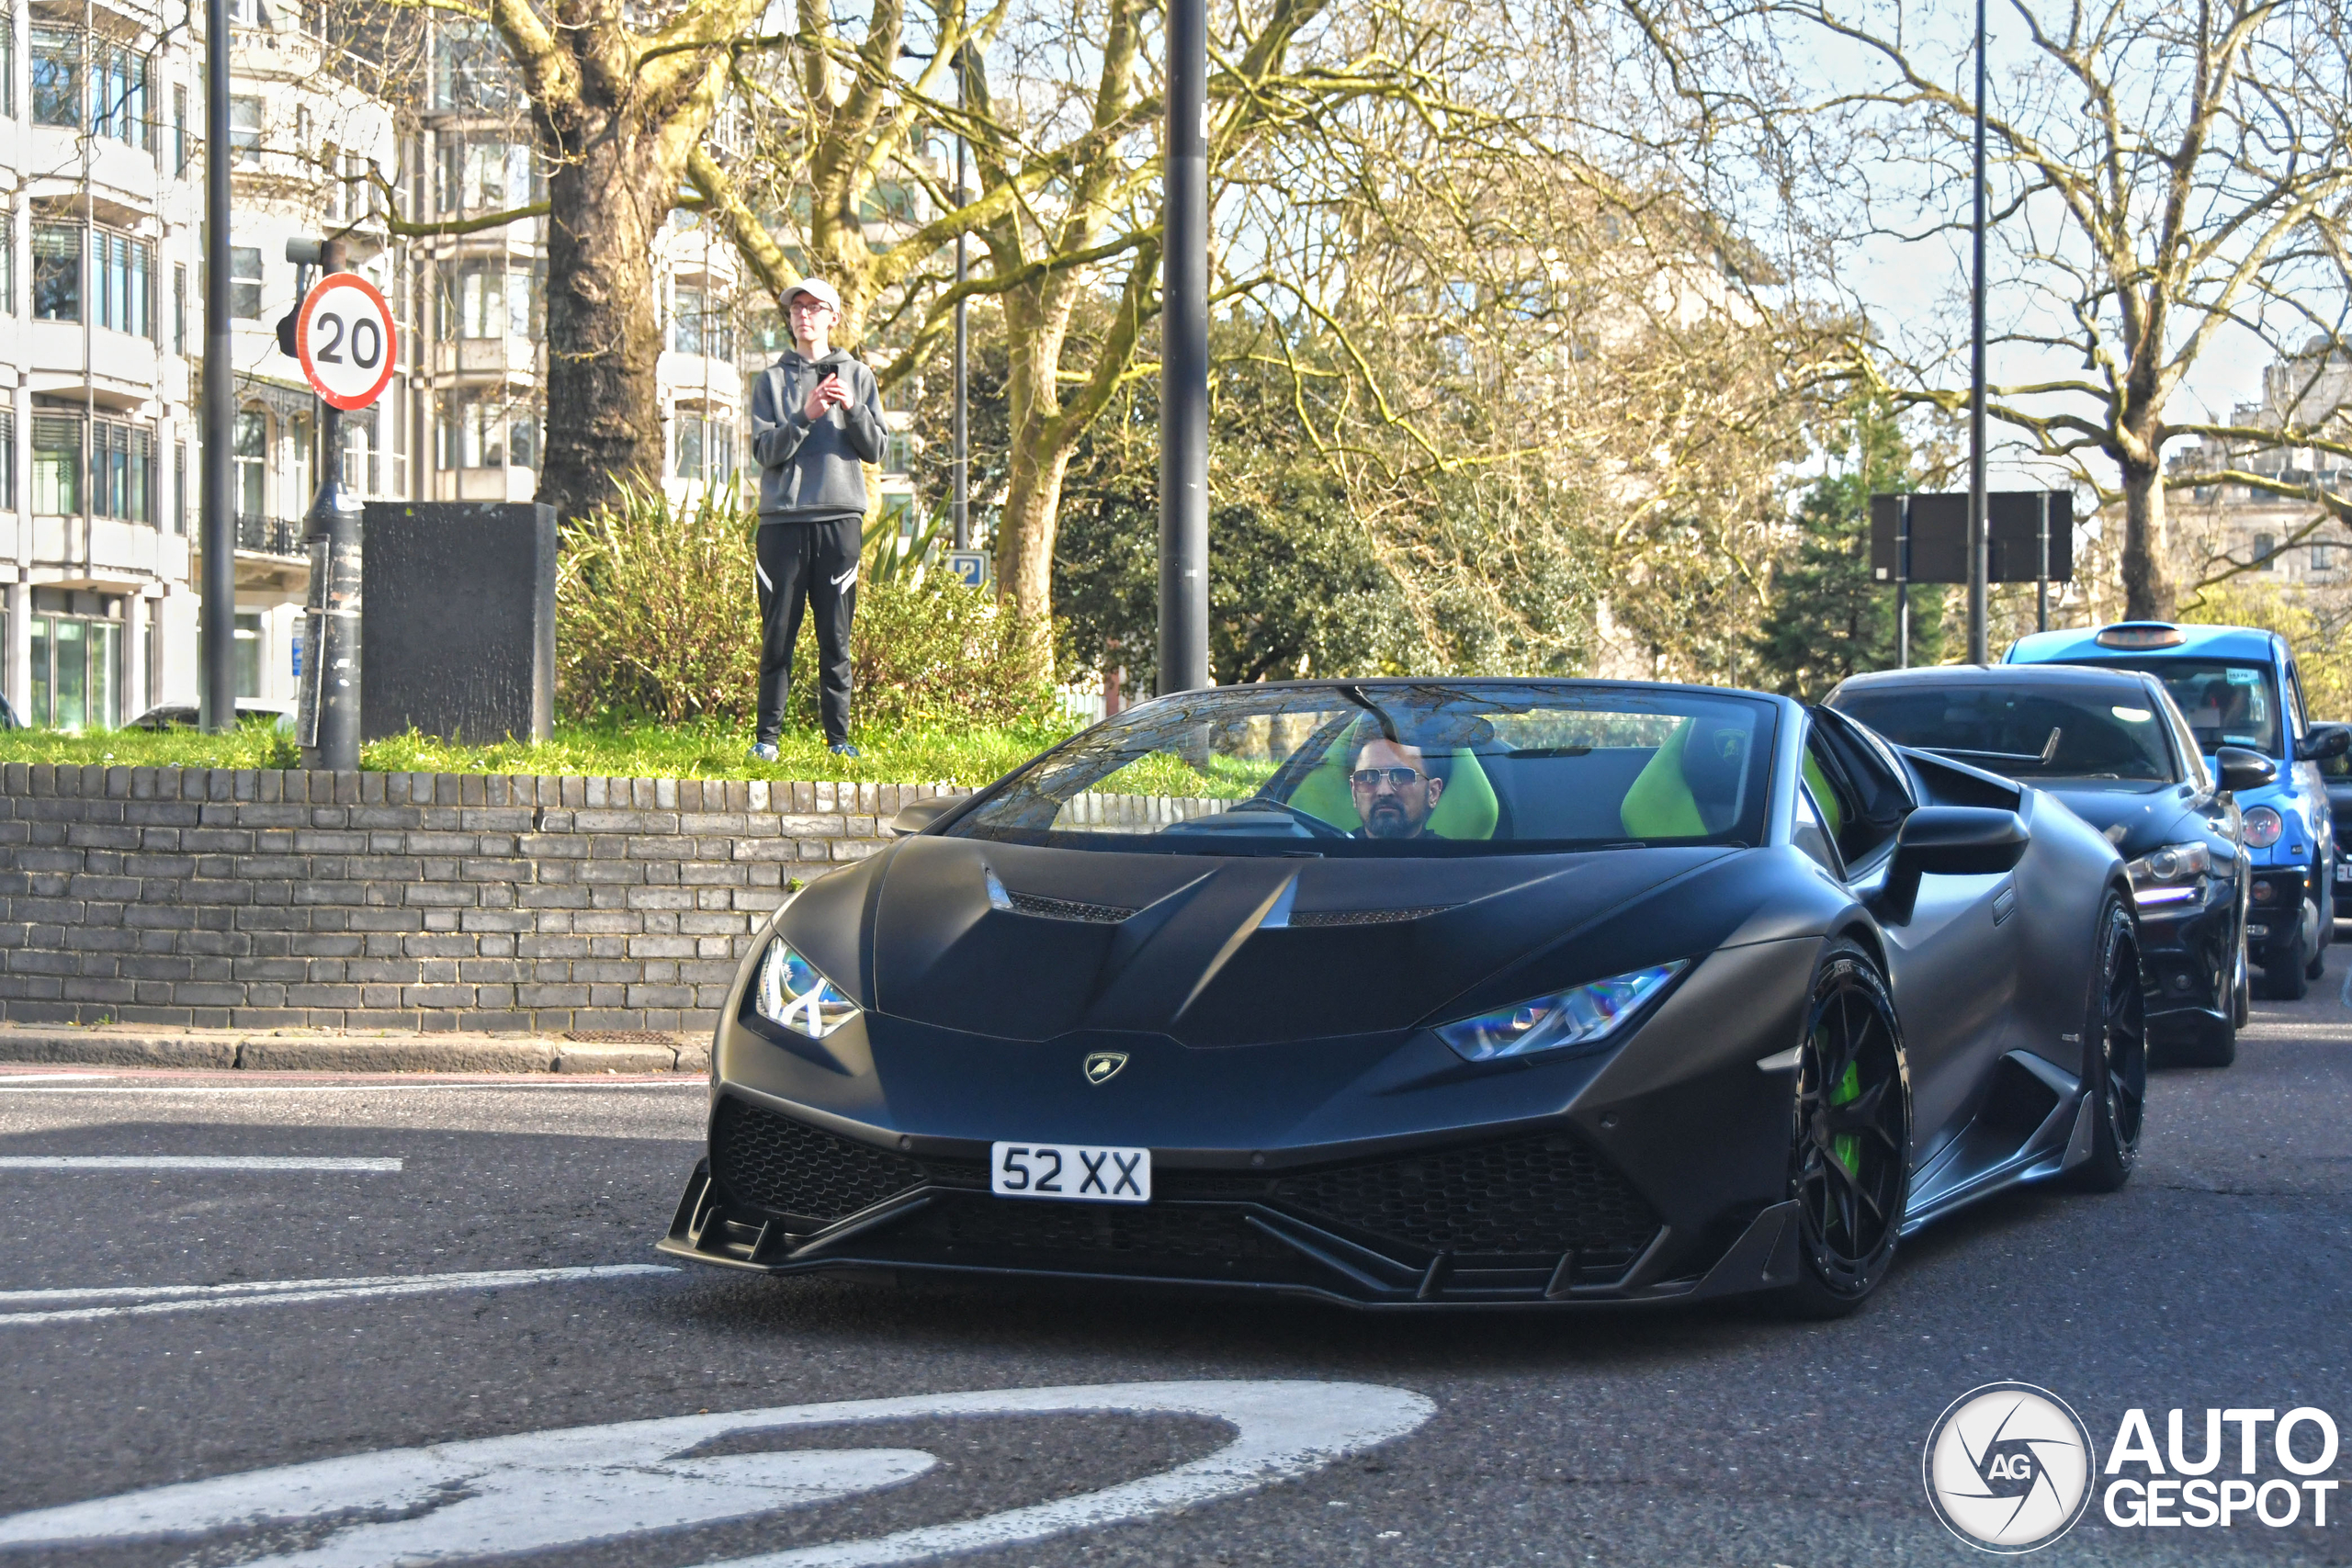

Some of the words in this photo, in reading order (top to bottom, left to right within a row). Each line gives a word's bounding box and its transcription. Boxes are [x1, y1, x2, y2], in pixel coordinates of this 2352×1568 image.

[317, 312, 381, 369] 20
[1002, 1146, 1062, 1192] 52
[1079, 1150, 1142, 1196] XX
